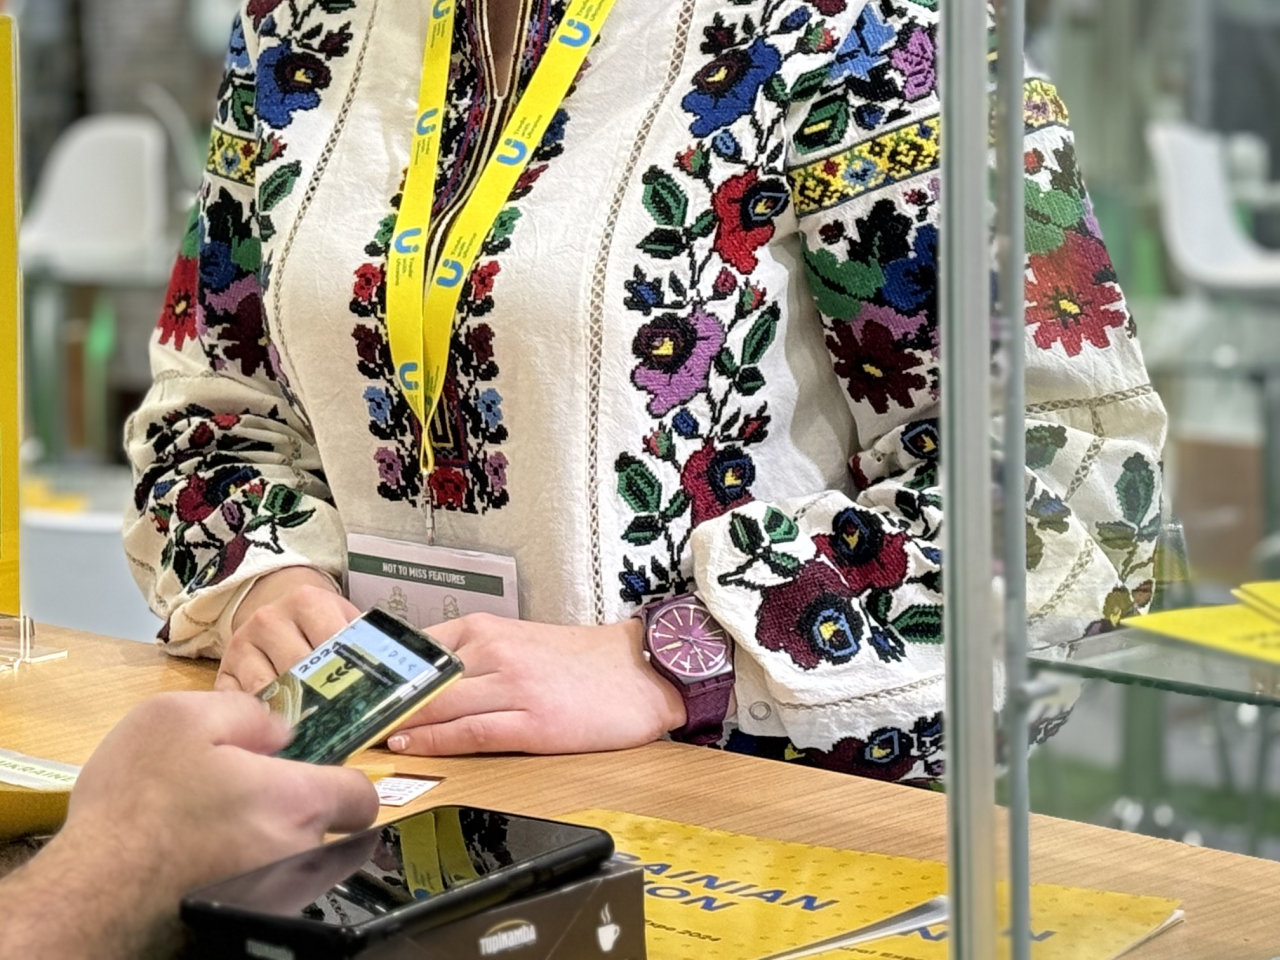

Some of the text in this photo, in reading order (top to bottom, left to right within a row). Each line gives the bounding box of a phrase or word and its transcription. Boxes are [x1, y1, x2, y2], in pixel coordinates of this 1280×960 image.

[382, 562, 466, 585] NOT TO MISS FEATURES
[298, 641, 342, 673] 2024
[676, 929, 722, 942] 2024
